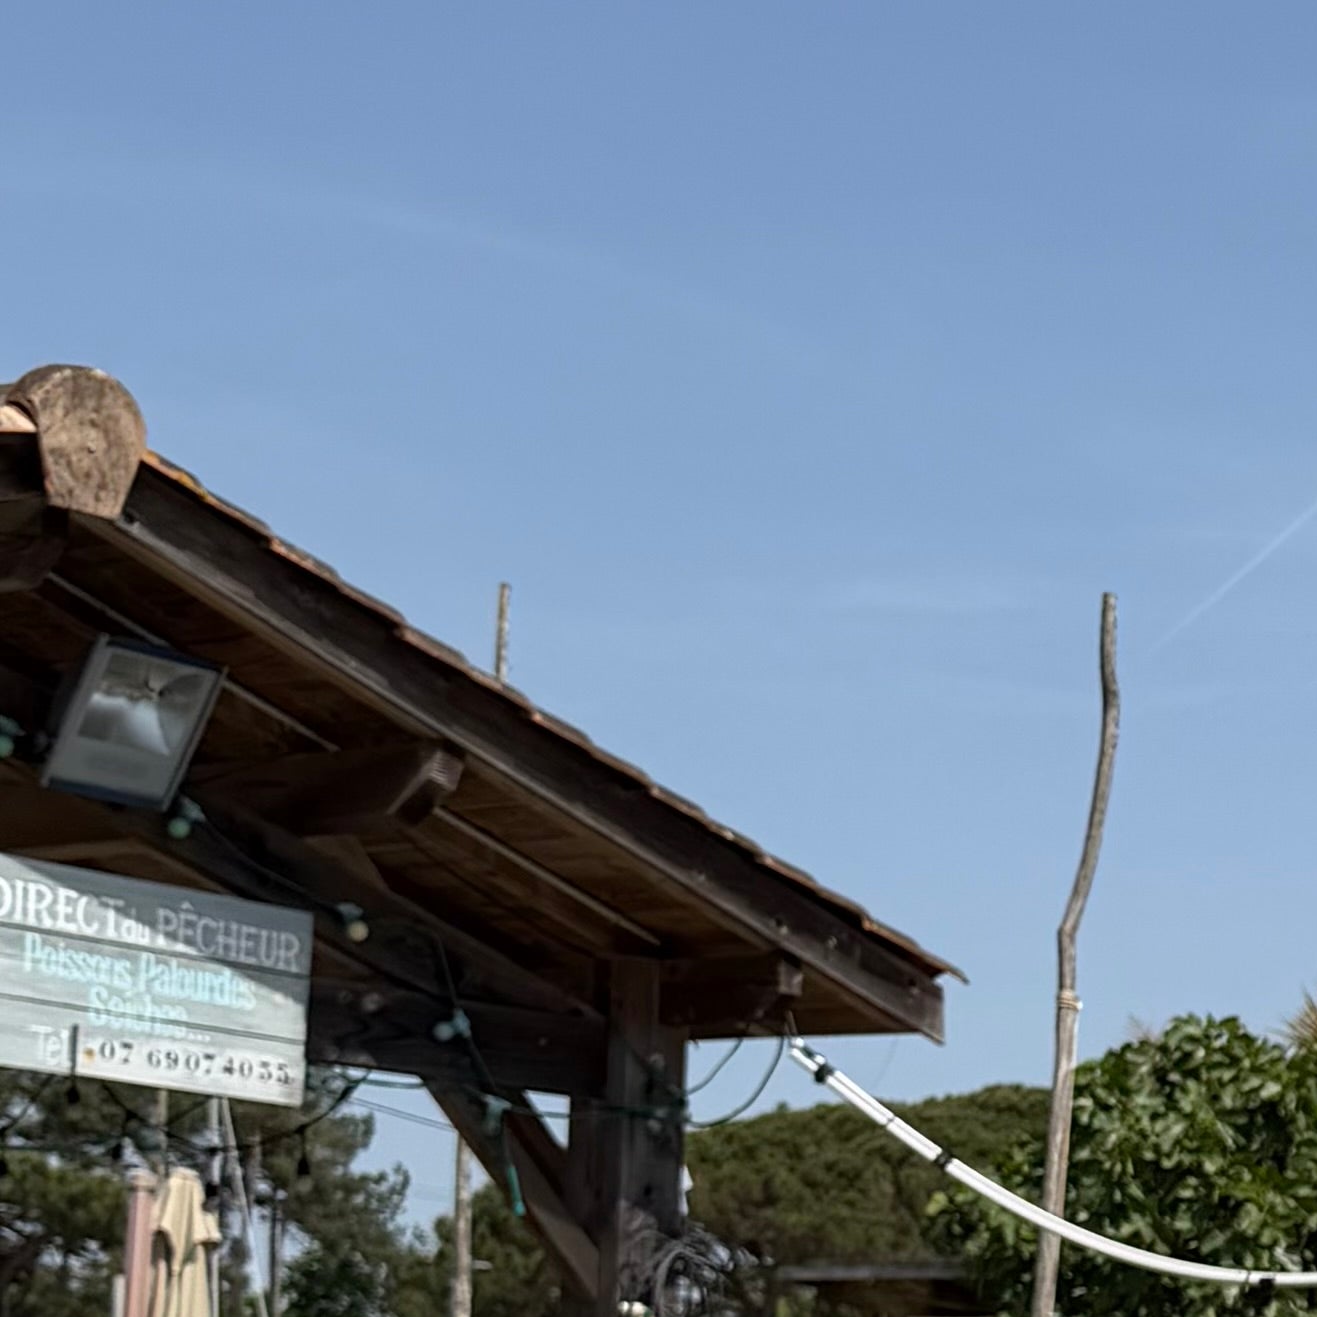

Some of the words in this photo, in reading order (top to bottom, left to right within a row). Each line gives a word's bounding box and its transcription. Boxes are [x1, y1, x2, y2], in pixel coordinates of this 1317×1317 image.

[24, 933, 133, 989] Poissons
[138, 953, 257, 1011] Palourdes
[157, 902, 301, 973] PÊCHEUR
[99, 1039, 135, 1065] 07
